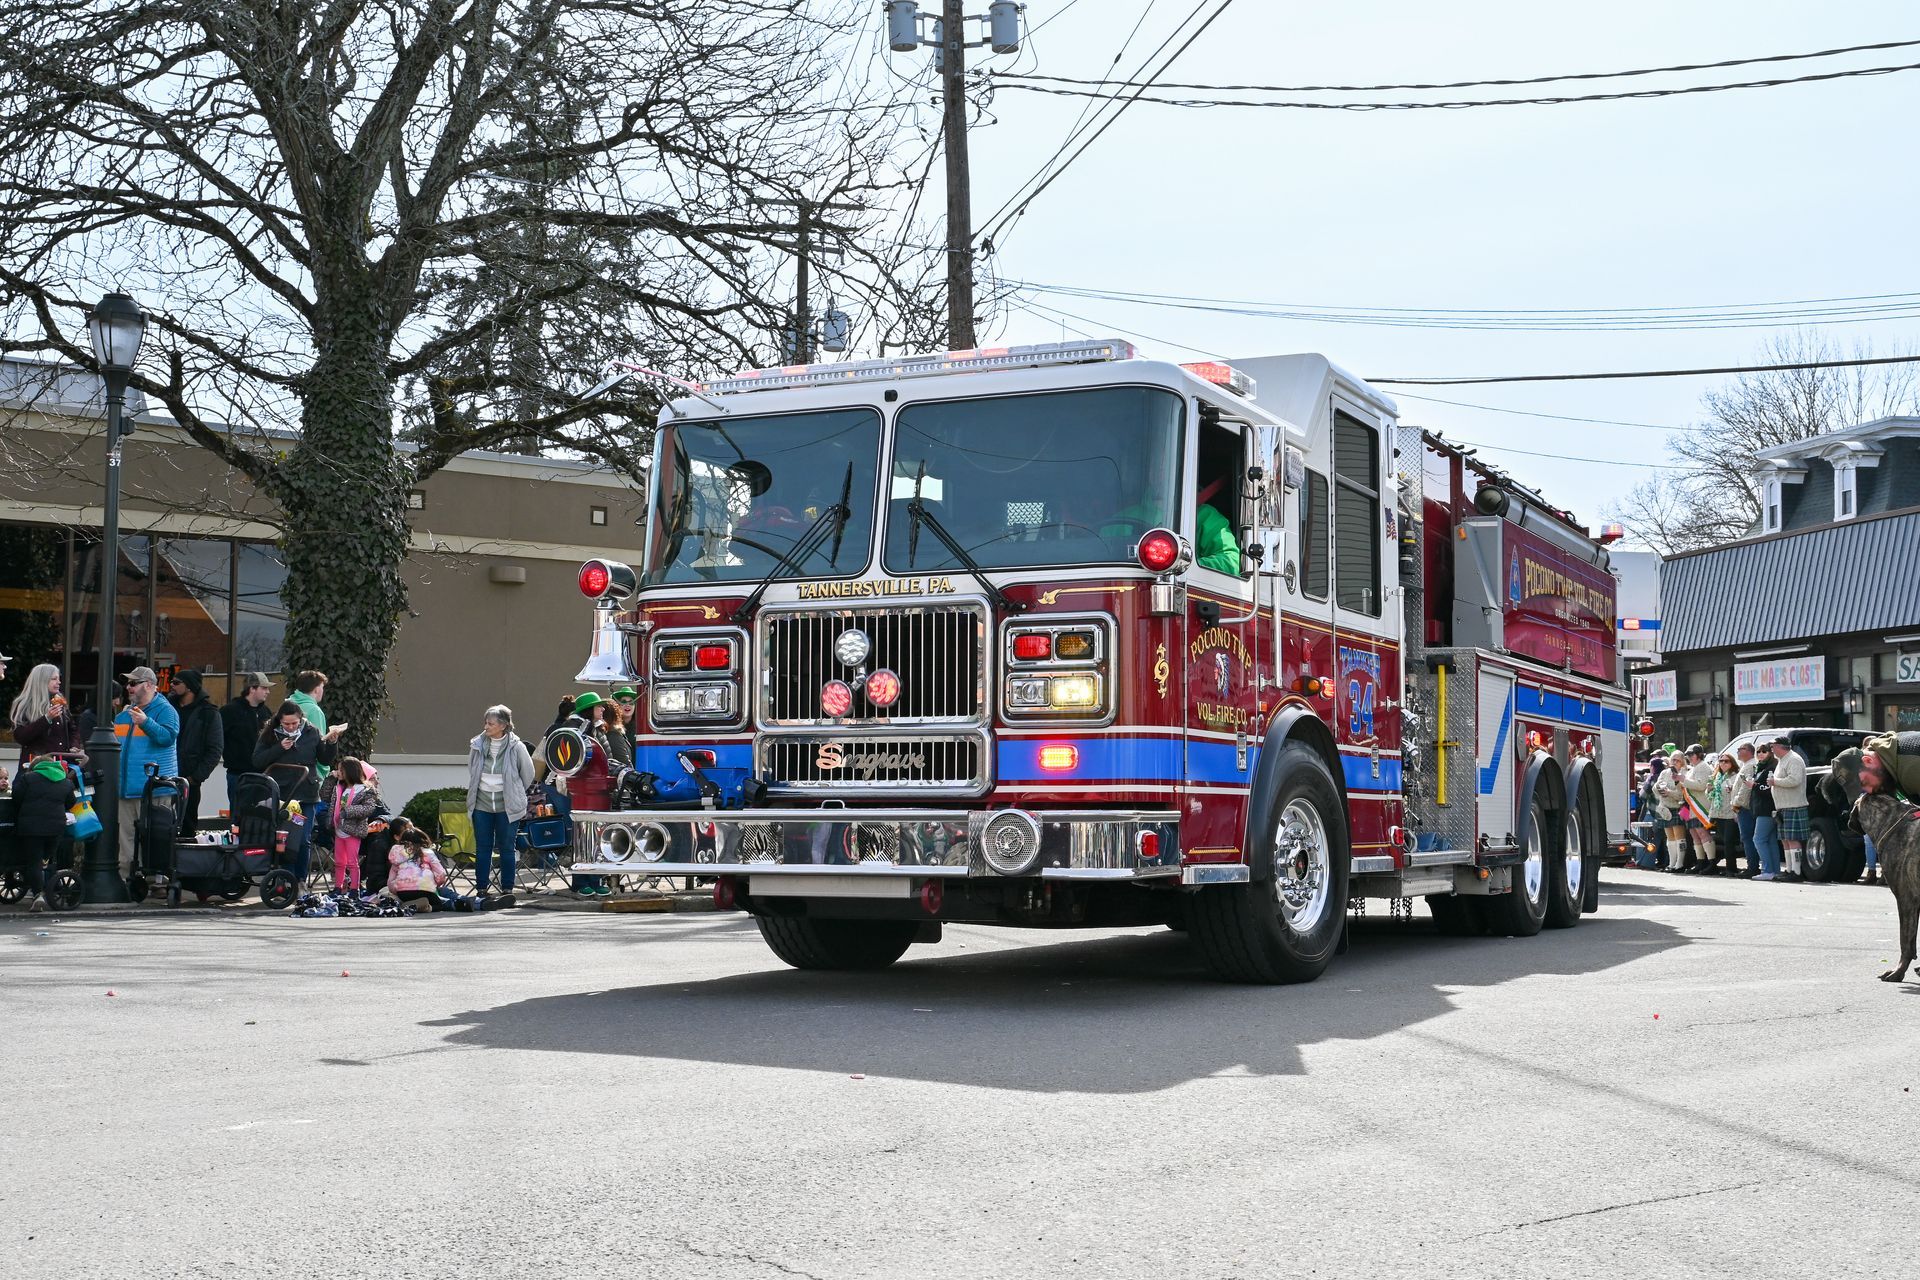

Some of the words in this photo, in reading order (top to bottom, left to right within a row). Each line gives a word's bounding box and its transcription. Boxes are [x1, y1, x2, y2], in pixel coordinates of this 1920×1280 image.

[109, 458, 121, 467] 37
[798, 577, 924, 599] TANNERSVILLE,
[928, 576, 956, 595] PA.
[1524, 557, 1555, 599] POCONO
[1588, 588, 1604, 621] FIRE
[1190, 627, 1231, 664] POCONO
[1649, 677, 1673, 699] CLOSET
[1737, 669, 1758, 690] ELLIE
[1760, 664, 1787, 689] MAE'S
[1789, 663, 1821, 687] CLOSET
[1216, 704, 1235, 724] FIRE
[1349, 679, 1374, 736] 34
[816, 742, 926, 781] Seagrave
